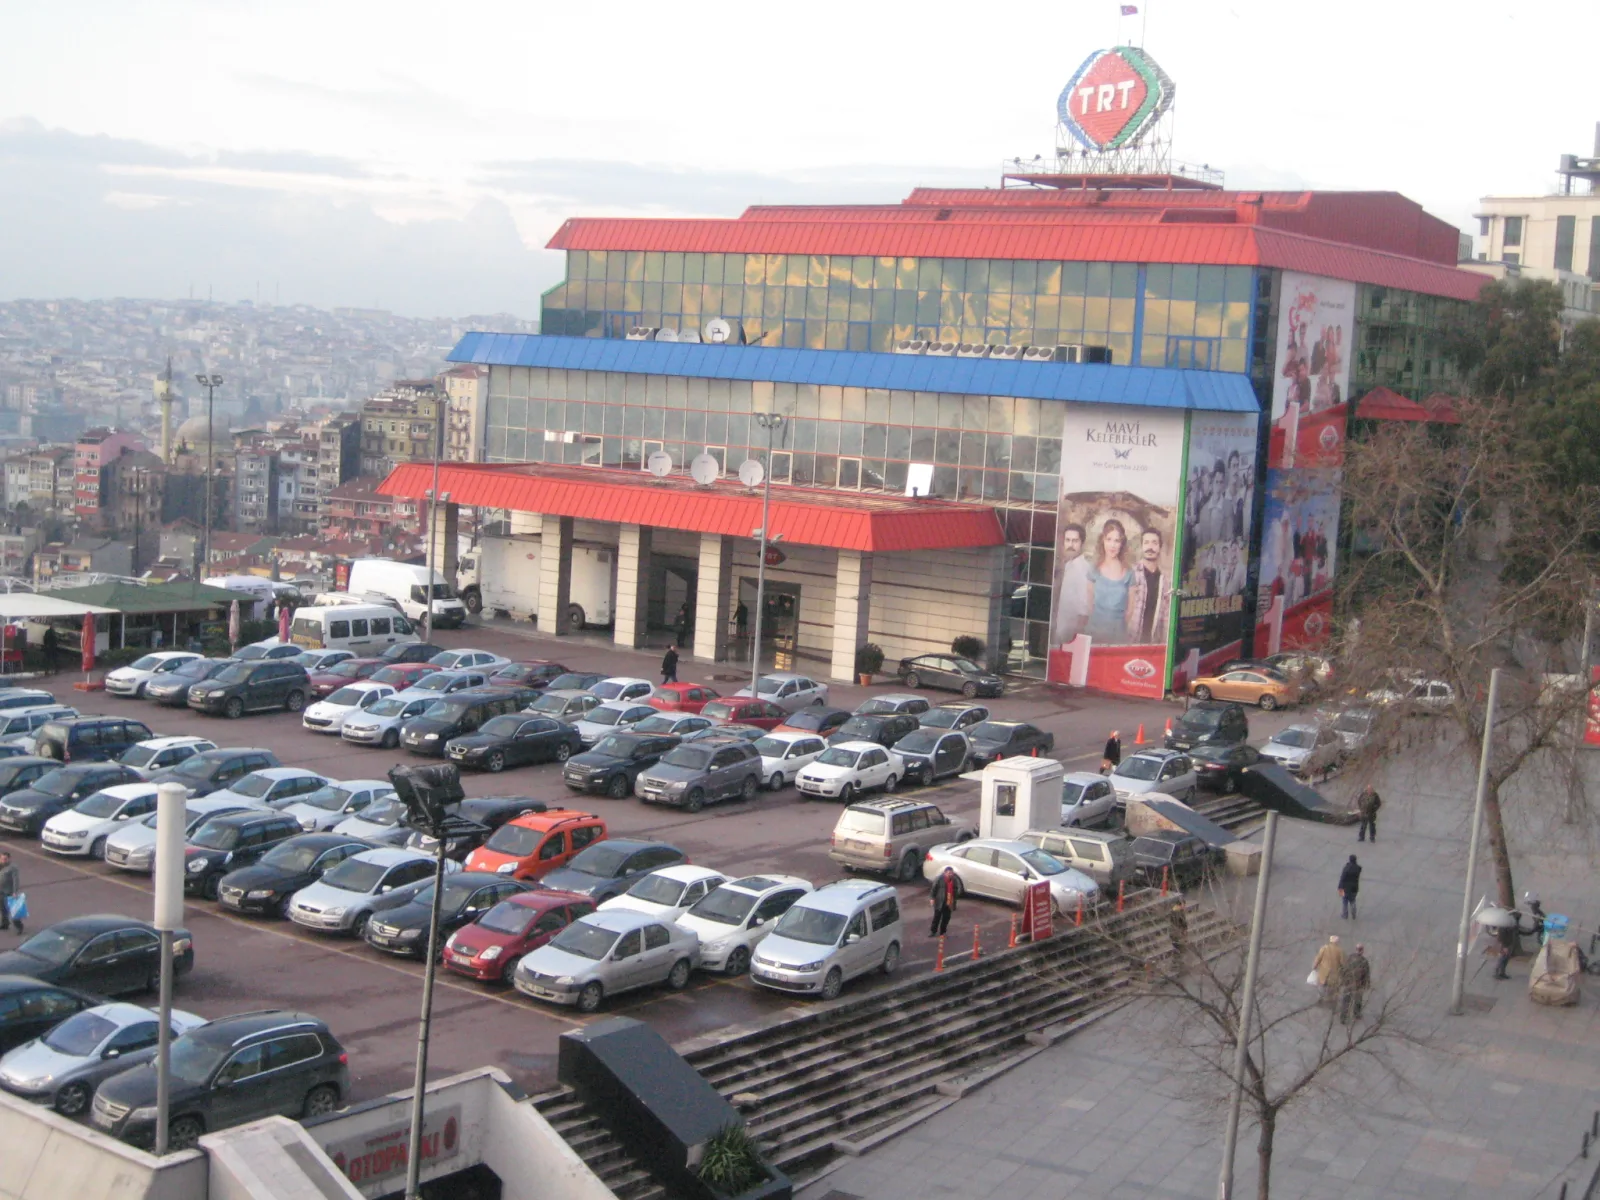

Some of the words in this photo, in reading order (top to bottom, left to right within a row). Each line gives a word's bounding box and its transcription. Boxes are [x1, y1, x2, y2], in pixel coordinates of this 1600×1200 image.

[1078, 79, 1136, 116] TRT
[1086, 428, 1159, 447] KELEBEKLER
[1105, 420, 1141, 435] MAVİ
[1061, 633, 1092, 687] 1
[349, 1131, 440, 1182] OTOPAKI
